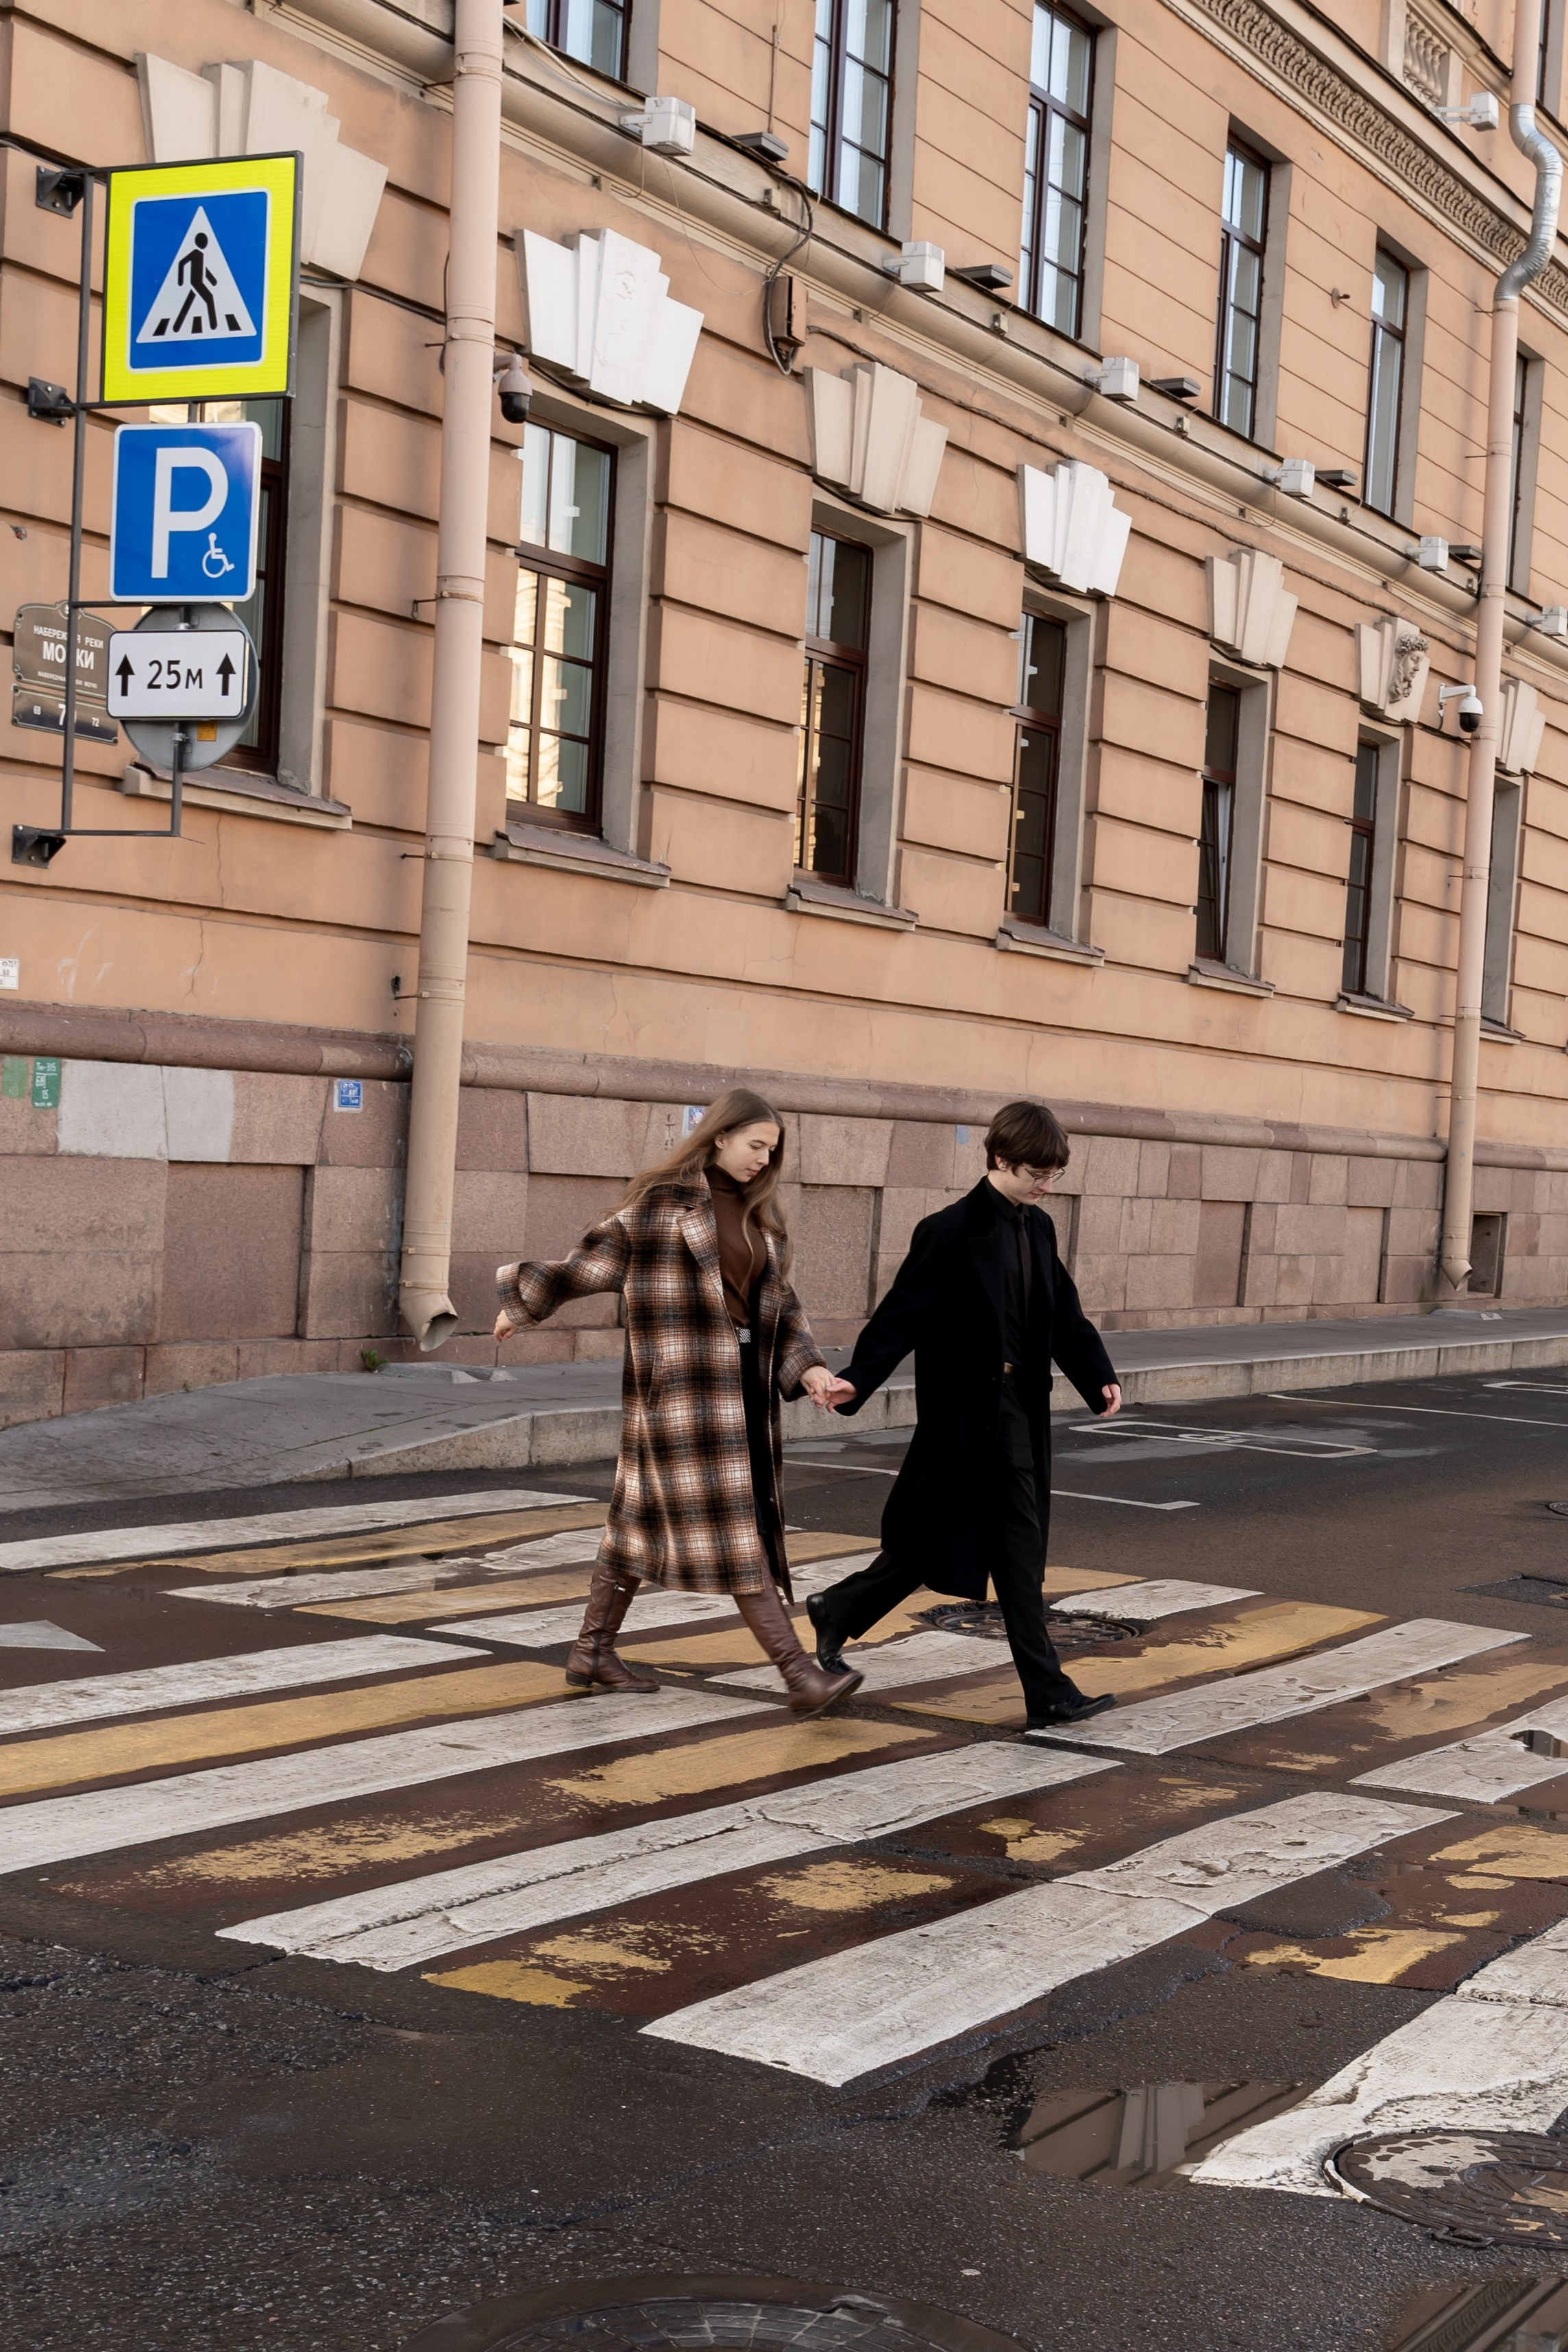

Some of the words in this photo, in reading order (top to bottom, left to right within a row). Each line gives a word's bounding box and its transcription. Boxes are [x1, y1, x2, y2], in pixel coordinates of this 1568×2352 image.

[151, 447, 228, 578] P
[34, 625, 81, 644] НАБЕРЕЖЯ
[84, 636, 103, 649] РЕКИ
[42, 641, 95, 670] МОКИ
[92, 717, 99, 727] 72
